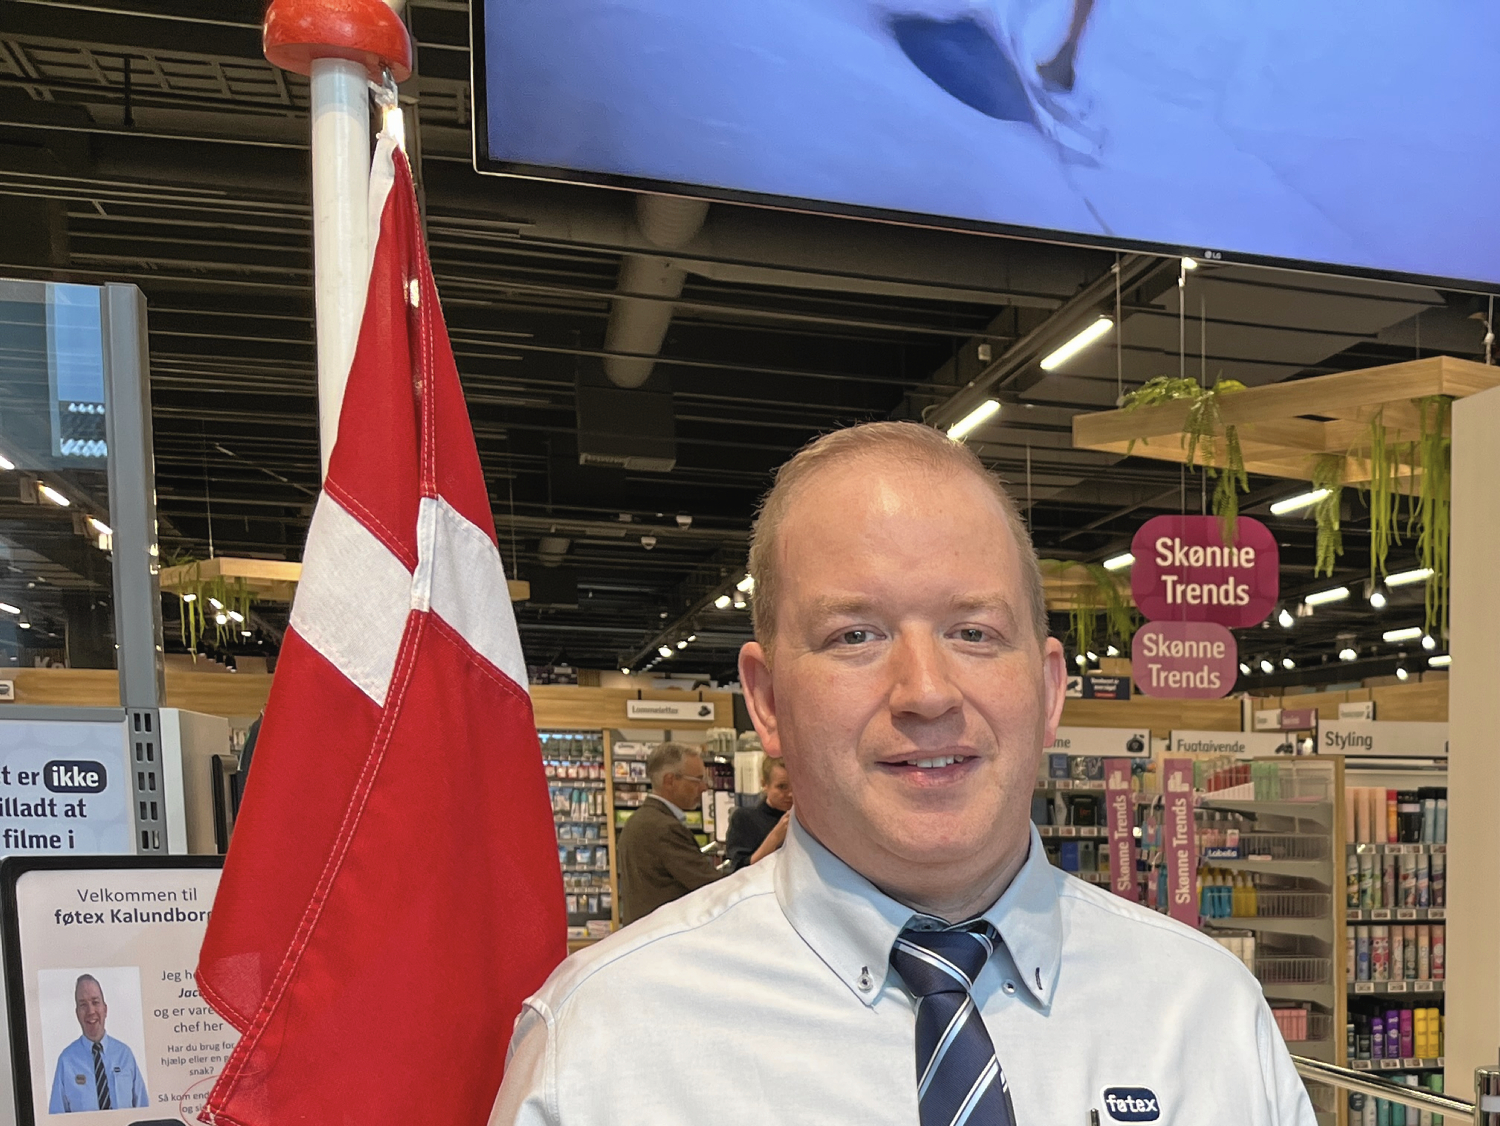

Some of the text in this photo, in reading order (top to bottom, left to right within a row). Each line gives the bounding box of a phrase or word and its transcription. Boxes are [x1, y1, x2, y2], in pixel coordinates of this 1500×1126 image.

[1155, 537, 1255, 568] Skønne
[1160, 574, 1250, 606] Trends
[1142, 632, 1226, 658] Skønne
[1147, 663, 1221, 689] Trends
[1325, 731, 1373, 750] Styling
[18, 770, 40, 786] er
[51, 766, 99, 787] ikke
[64, 798, 87, 818] at
[3, 829, 75, 849] filme i
[1113, 795, 1131, 891] Skønne Trends
[1171, 798, 1191, 905] Skønne Trends
[77, 887, 198, 903] Velkommen til
[54, 909, 105, 926] føtex
[161, 970, 182, 983] Jeg
[153, 1007, 215, 1020] og er vare
[174, 1021, 224, 1033] chef her
[167, 1041, 235, 1053] Har du brug for
[161, 1057, 187, 1067] hjælp
[188, 1055, 209, 1064] eller
[189, 1067, 215, 1076] snak?
[158, 1094, 169, 1103] Så
[171, 1093, 191, 1102] kom
[1106, 1093, 1158, 1112] føtex
[182, 1105, 194, 1114] og
